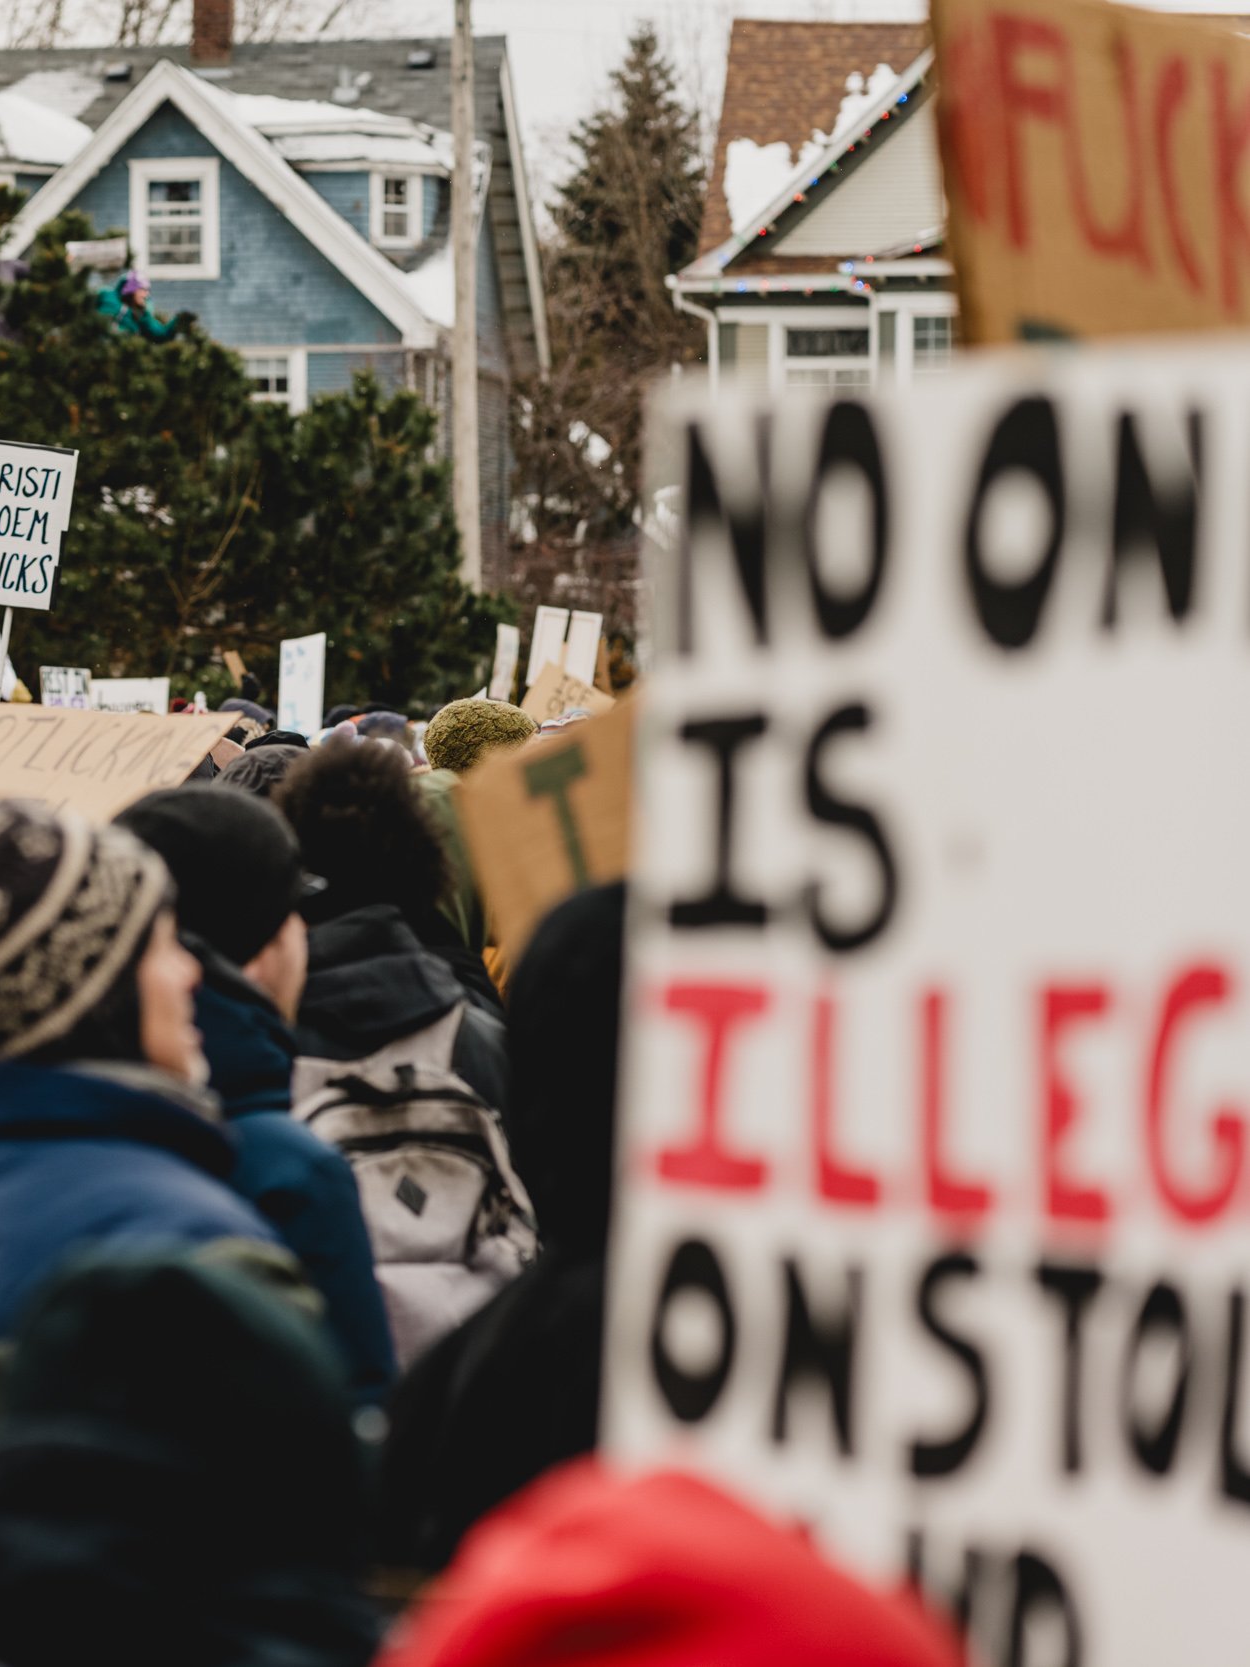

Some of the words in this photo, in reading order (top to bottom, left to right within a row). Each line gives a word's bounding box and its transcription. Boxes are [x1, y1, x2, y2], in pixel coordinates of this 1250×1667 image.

[674, 396, 889, 660] NO
[667, 702, 899, 953] IS
[654, 967, 1247, 1226] ILLEG
[652, 1238, 864, 1460] ON
